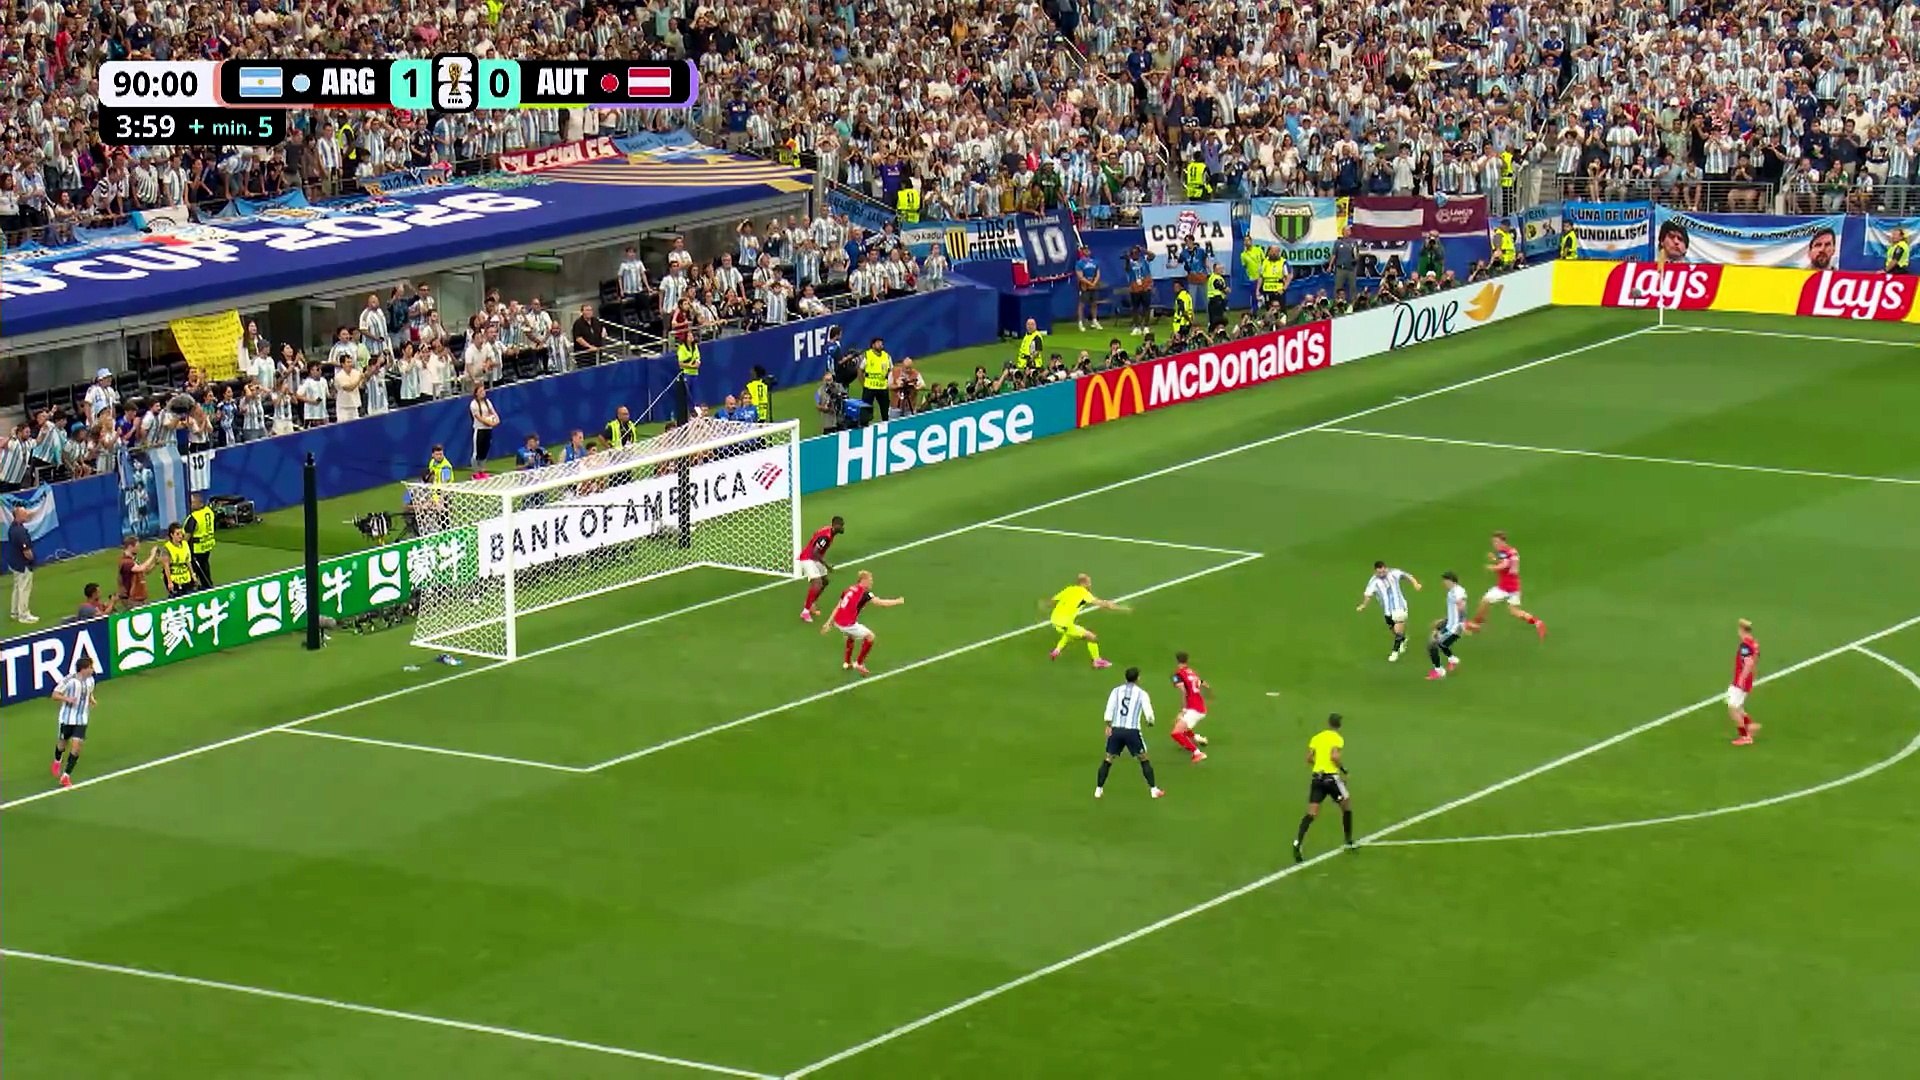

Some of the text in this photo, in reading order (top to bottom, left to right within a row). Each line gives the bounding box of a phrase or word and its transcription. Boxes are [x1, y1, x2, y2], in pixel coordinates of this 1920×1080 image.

[53, 236, 240, 281] CUP
[226, 191, 542, 252] 2026
[977, 219, 1005, 240] LOS
[1152, 221, 1225, 242] COTA
[1570, 207, 1600, 222] LUNA
[1027, 226, 1068, 266] 10
[1166, 240, 1215, 262] RA
[1617, 262, 1707, 309] Lay's
[1812, 269, 1905, 318] Lay's
[794, 325, 835, 361] FIF
[1390, 303, 1458, 348] Dove
[1150, 330, 1325, 406] McDonald's
[192, 454, 205, 470] 10
[836, 404, 1034, 486] Hisense
[490, 469, 747, 563] BANK OF AMERICA
[160, 596, 230, 656] 蒙牛
[0, 629, 104, 698] TRA
[1120, 696, 1131, 716] 5
